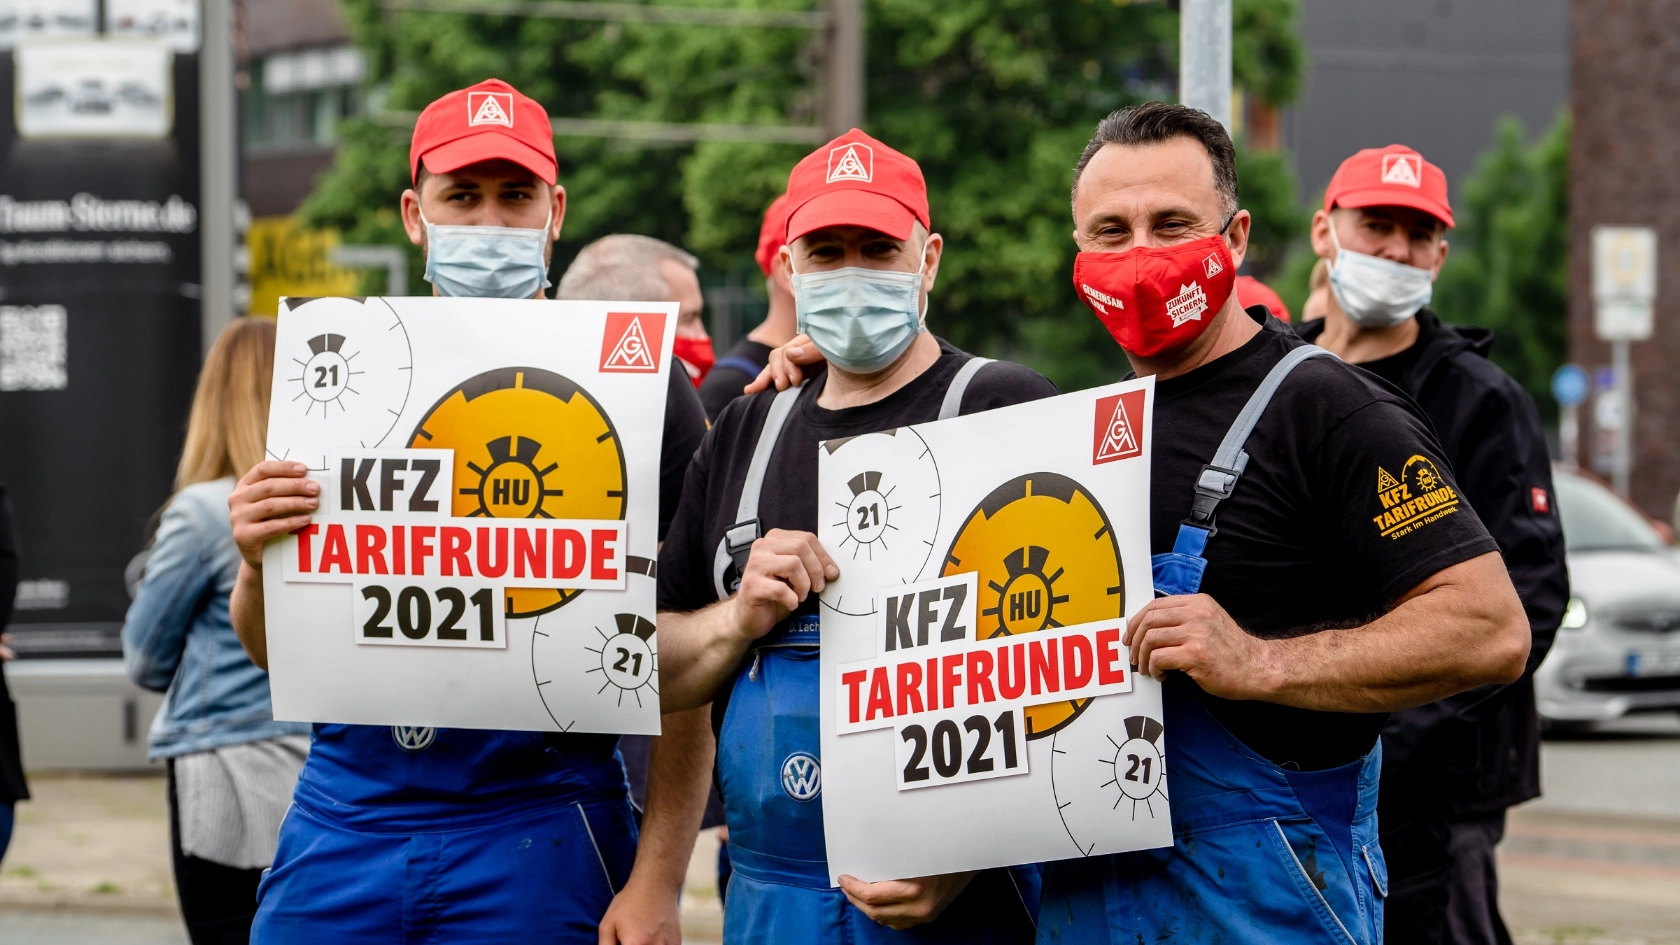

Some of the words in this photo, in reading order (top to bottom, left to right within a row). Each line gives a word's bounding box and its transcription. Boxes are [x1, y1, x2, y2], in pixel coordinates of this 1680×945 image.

[1083, 283, 1124, 310] GEMEINSAM
[1168, 288, 1200, 310] ZUKUNFT
[1172, 297, 1206, 319] SICHERN.
[314, 364, 338, 388] 21
[340, 458, 441, 512] KFZ
[492, 479, 530, 506] HU
[1379, 483, 1412, 509] KFZ
[857, 502, 880, 531] 21
[1373, 485, 1457, 531] TARIFRUNDE
[1391, 526, 1413, 540] Stark
[1413, 521, 1424, 530] im
[295, 523, 619, 580] TARIFRUNDE
[362, 585, 495, 641] 2021
[885, 583, 967, 653] KFZ
[1010, 588, 1041, 622] HU
[613, 647, 643, 677] 21
[842, 628, 1124, 724] TARIFRUNDE
[901, 711, 1019, 783] 2021
[1125, 754, 1152, 785] 21
